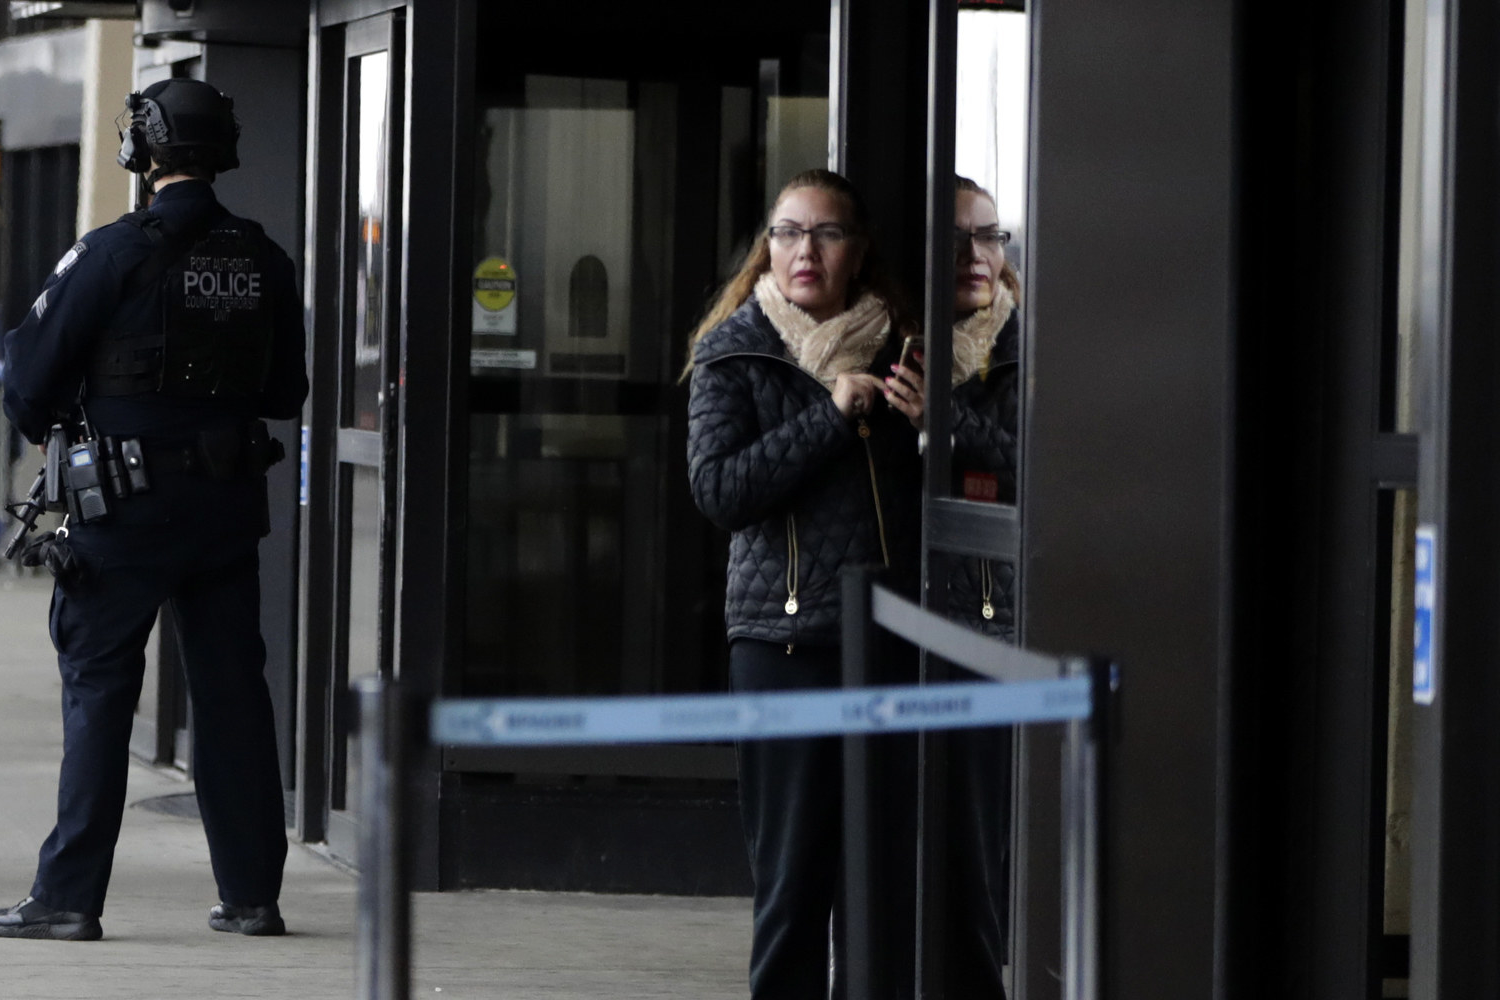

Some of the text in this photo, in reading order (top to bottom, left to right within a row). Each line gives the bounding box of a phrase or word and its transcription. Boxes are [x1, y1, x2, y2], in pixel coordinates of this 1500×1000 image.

[190, 256, 254, 272] PORT AUTHORITY
[183, 271, 261, 297] POLICE
[185, 295, 220, 309] COUNTER
